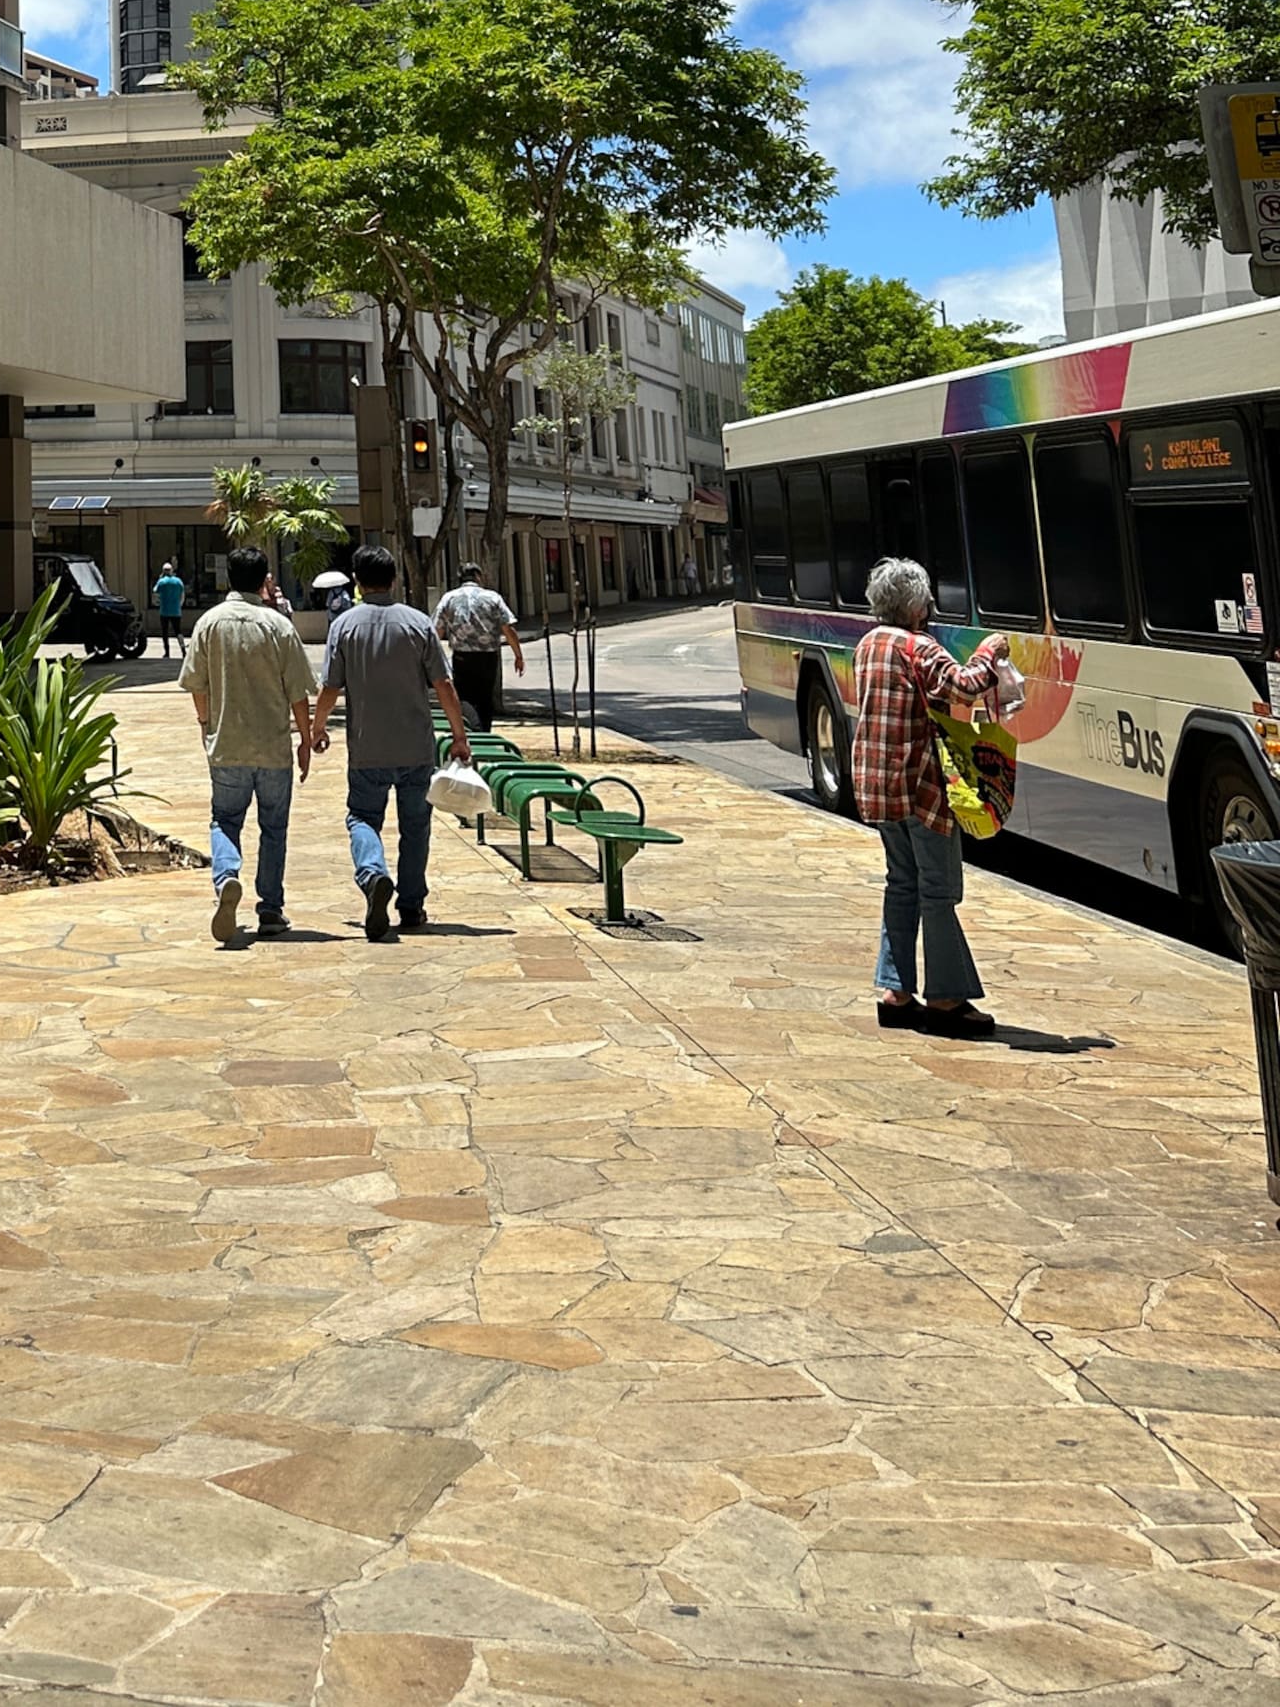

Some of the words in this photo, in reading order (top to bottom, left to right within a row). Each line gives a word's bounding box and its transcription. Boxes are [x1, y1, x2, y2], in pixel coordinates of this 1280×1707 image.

[1252, 181, 1268, 191] NO
[1168, 437, 1221, 455] KAPIOLANI
[1144, 444, 1153, 471] 3
[1162, 456, 1189, 470] COMM
[1190, 452, 1232, 468] COLLEGE
